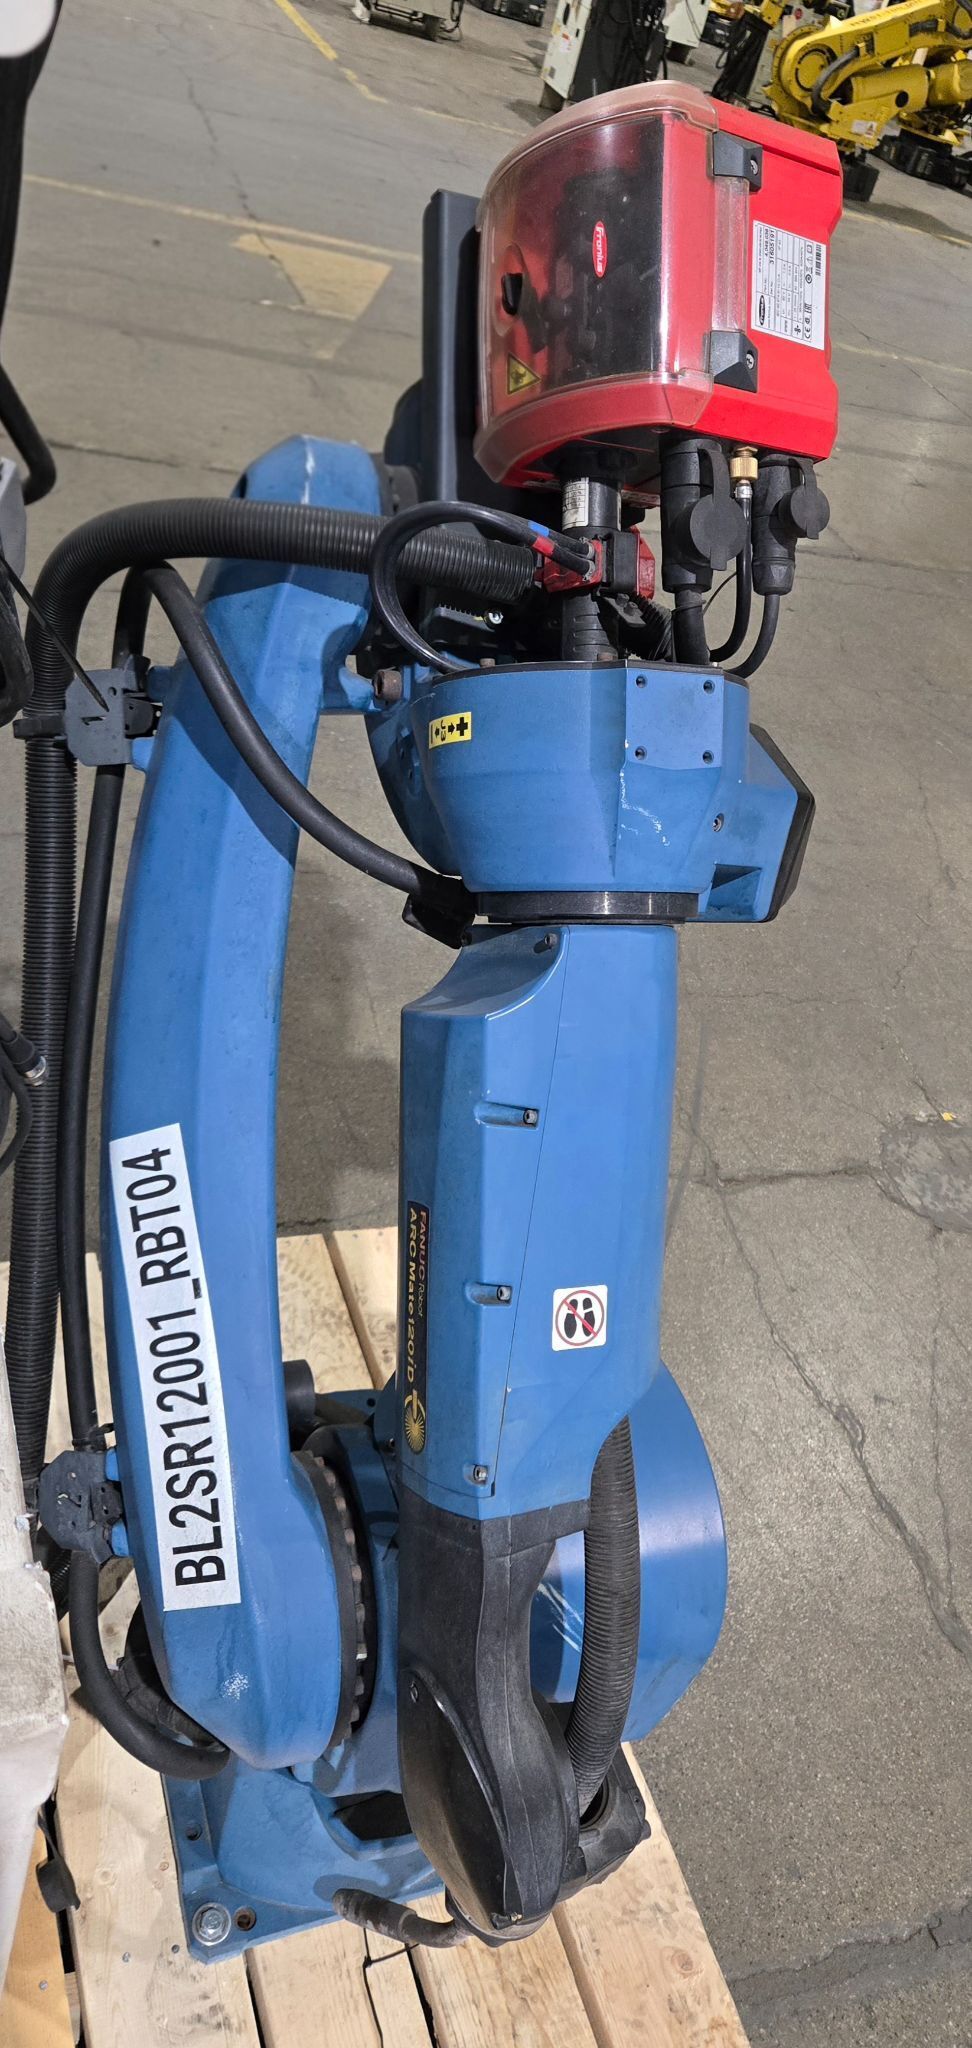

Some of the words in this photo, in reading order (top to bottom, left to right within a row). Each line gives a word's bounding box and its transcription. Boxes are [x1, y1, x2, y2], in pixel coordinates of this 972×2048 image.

[595, 226, 604, 273] Fronius
[440, 719, 447, 742] J3
[409, 1207, 417, 1258] ARC
[418, 1210, 427, 1281] FANUC
[408, 1261, 416, 1315] Mate
[121, 1147, 227, 1587] BL2SR12001_RBT04
